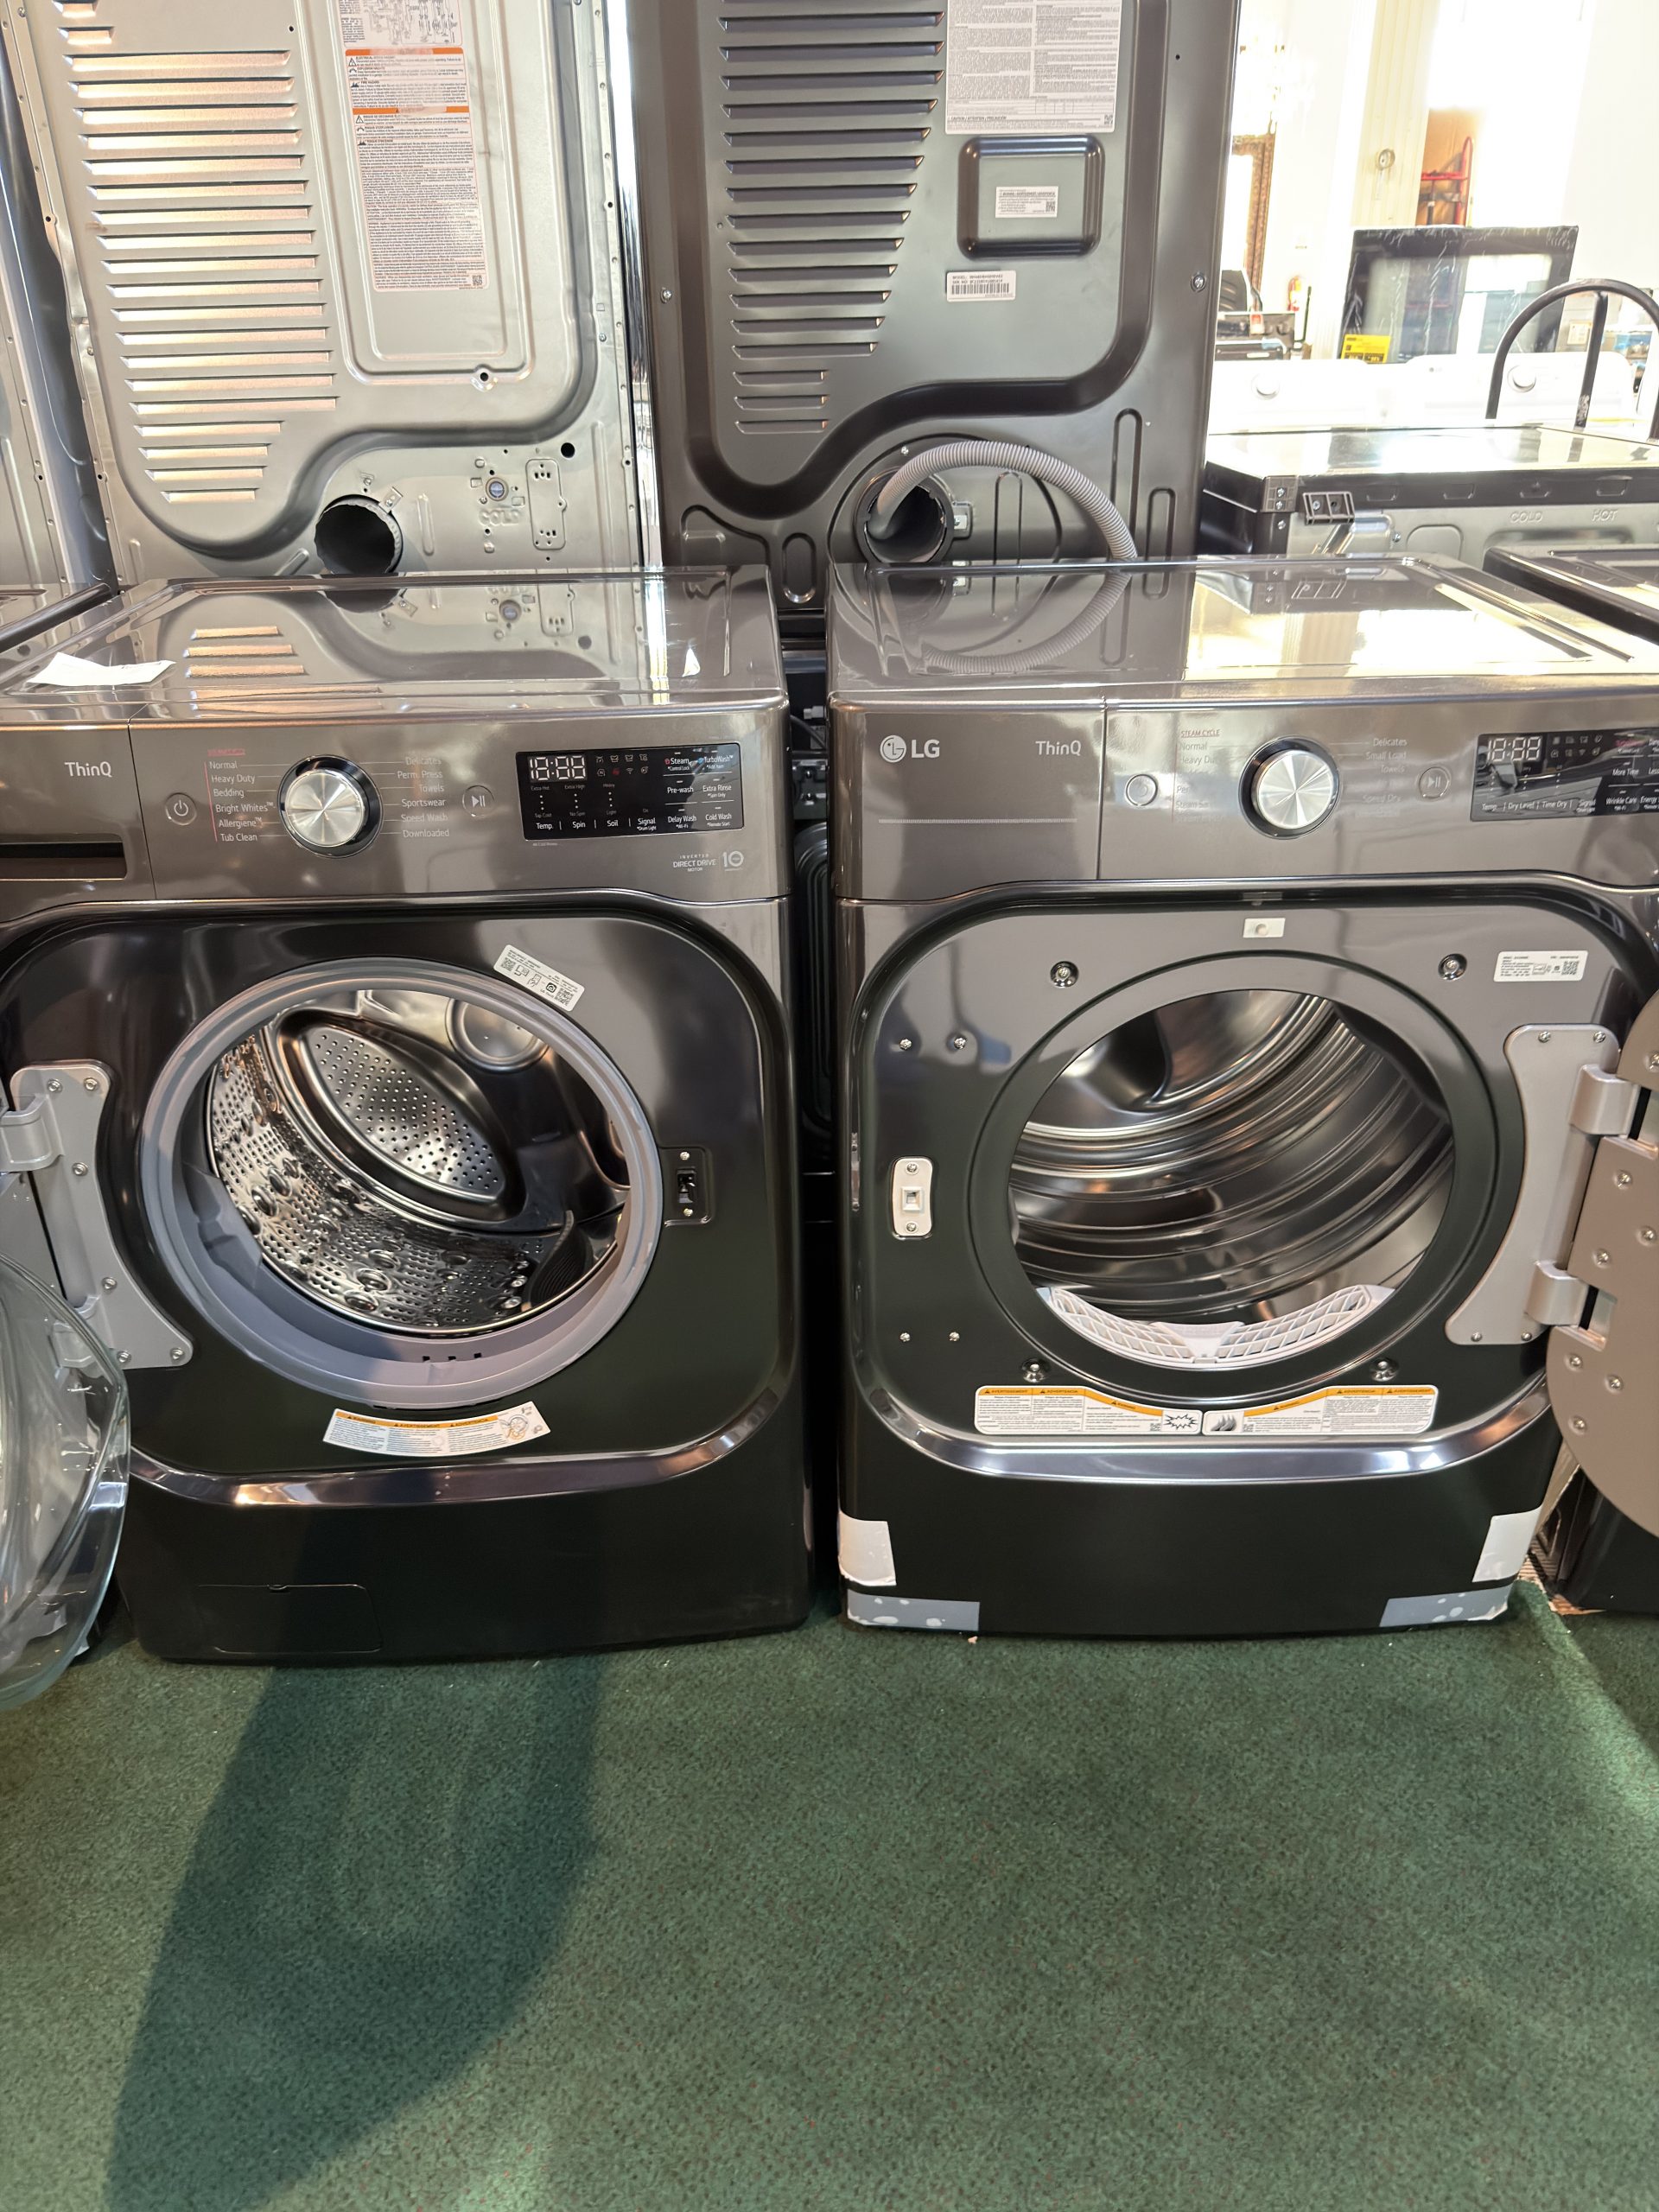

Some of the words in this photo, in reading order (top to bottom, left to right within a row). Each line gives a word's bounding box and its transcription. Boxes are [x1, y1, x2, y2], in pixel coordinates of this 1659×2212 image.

[1510, 511, 1544, 524] COLD
[1592, 508, 1618, 522] HOT
[1180, 729, 1201, 738] STEAM
[1373, 738, 1408, 747] Delicates
[911, 739, 940, 759] LG
[1035, 740, 1082, 756] ThinQ
[64, 761, 112, 778] ThinQ
[421, 770, 443, 779] Press
[212, 775, 235, 785] Heavy
[237, 774, 256, 784] Duty
[419, 783, 444, 792] Towels
[213, 788, 245, 798] Bedding
[401, 798, 446, 809] Sportswear
[1556, 800, 1567, 809] Dry
[215, 804, 238, 815] Bright
[401, 813, 425, 823] Speed
[427, 813, 448, 822] Wash
[638, 817, 656, 826] Signal
[572, 821, 586, 830] Spin
[220, 833, 234, 842] Tub
[236, 833, 257, 842] Clean
[403, 829, 449, 838] Downloaded
[672, 860, 696, 868] DIRECT
